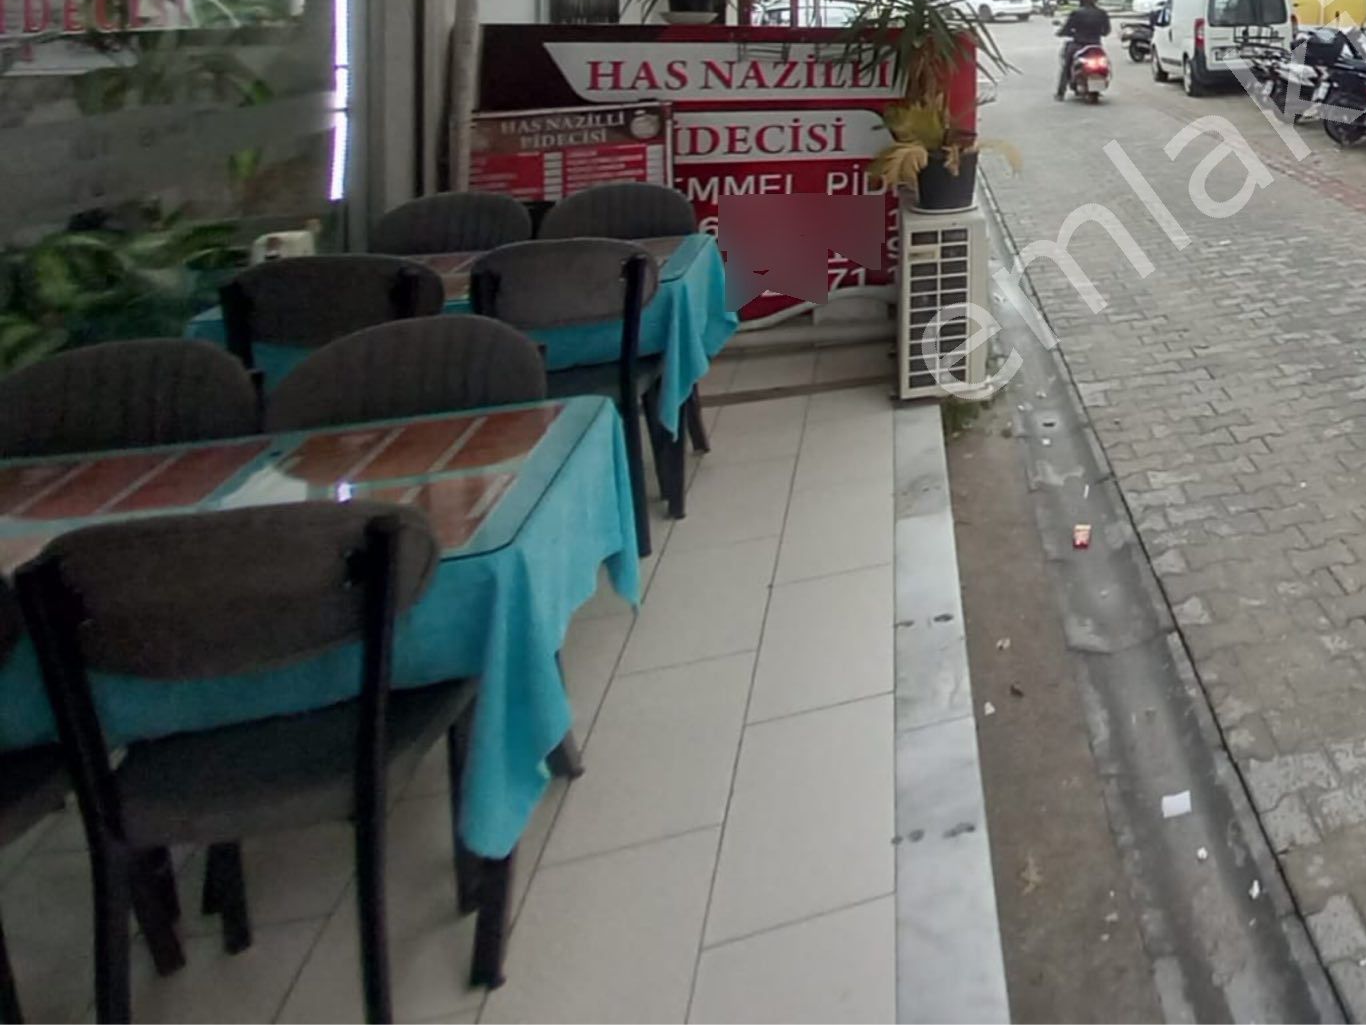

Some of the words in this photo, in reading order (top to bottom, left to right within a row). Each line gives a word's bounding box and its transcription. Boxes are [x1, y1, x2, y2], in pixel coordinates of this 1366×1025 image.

[586, 59, 689, 91] HAS
[500, 120, 541, 135] HAS
[673, 116, 848, 157] İDECİSİ
